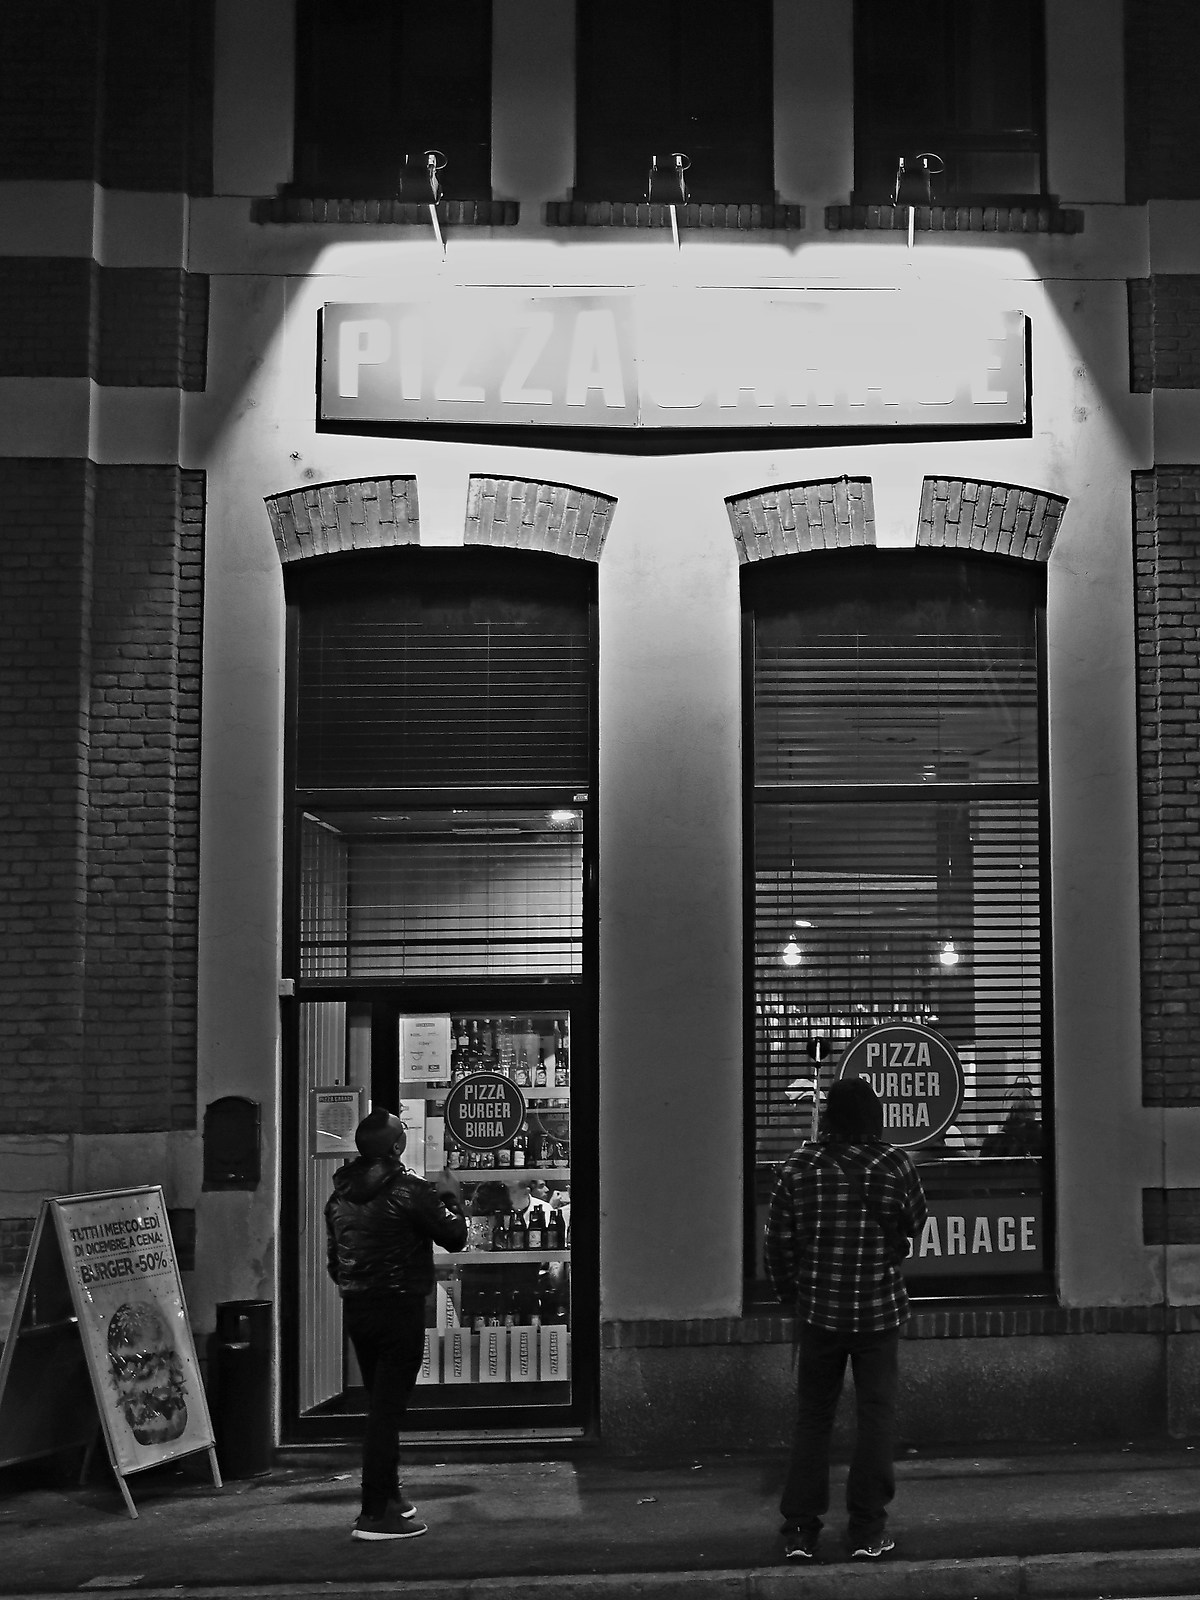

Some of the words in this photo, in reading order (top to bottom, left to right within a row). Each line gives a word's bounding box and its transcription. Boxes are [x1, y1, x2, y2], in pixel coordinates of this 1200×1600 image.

[339, 309, 626, 408] PIZZA
[866, 1042, 931, 1068] PIZZA
[465, 1084, 505, 1100] PIZZA
[858, 1072, 940, 1097] URGER
[460, 1102, 511, 1119] BURGER
[882, 1102, 930, 1128] IRRA
[466, 1121, 504, 1138] BIRRA
[70, 1225, 99, 1242] TUTTI
[74, 1244, 84, 1257] DI
[129, 1236, 136, 1248] A
[137, 1231, 164, 1246] CENA:
[905, 1216, 1037, 1259] ARAGE
[80, 1257, 135, 1284] BURGER
[135, 1251, 168, 1273] -50%
